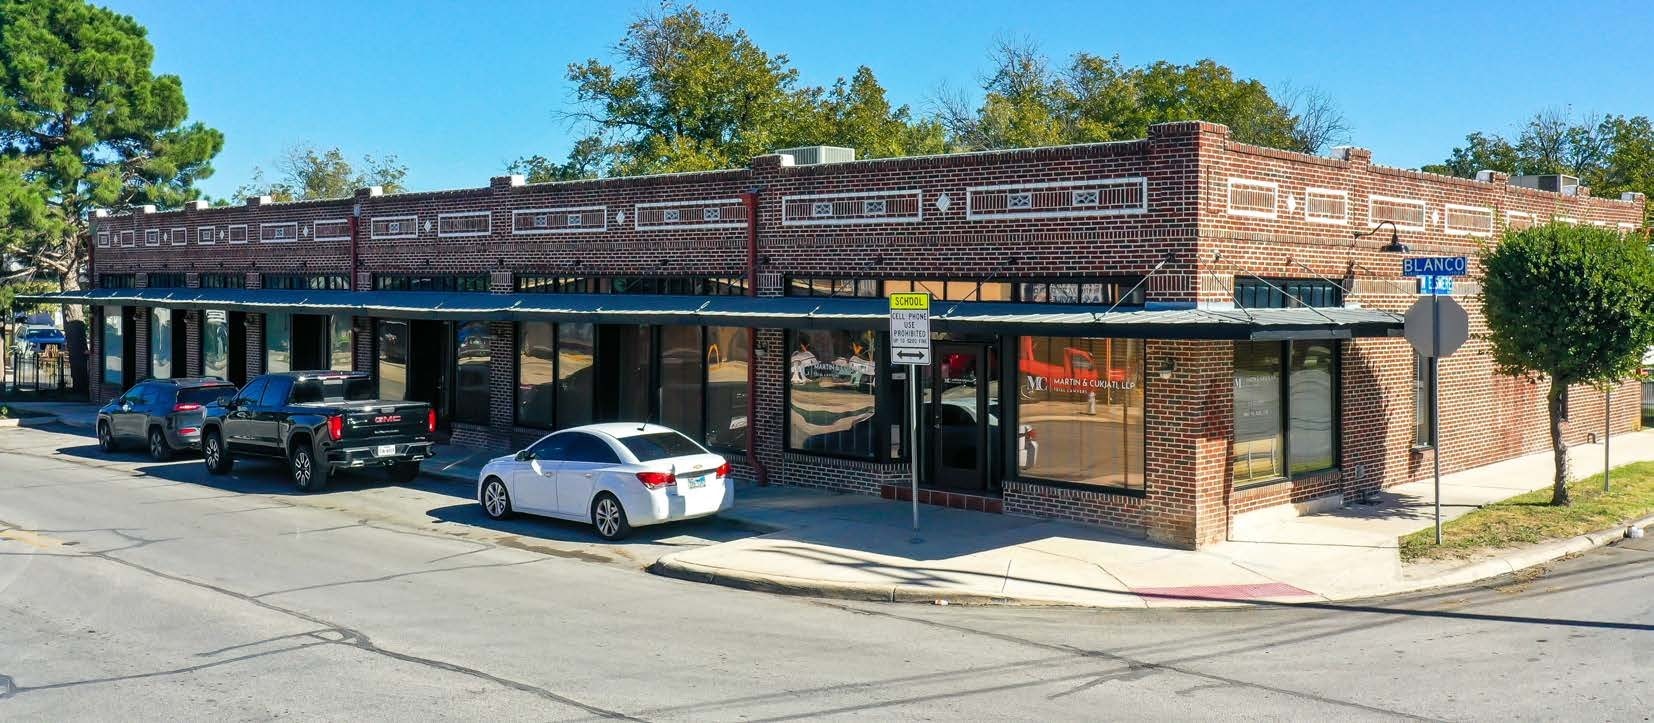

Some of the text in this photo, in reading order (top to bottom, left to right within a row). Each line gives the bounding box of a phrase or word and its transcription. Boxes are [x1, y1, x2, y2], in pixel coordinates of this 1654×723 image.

[1404, 257, 1464, 271] BLANCO
[895, 297, 923, 306] SCHOOL
[908, 313, 927, 321] PHONE
[894, 330, 926, 338] PROHIBITED
[1027, 375, 1048, 391] MC
[1054, 378, 1081, 386] MARTIN
[1082, 379, 1088, 387] &
[1121, 382, 1136, 390] LLP
[374, 415, 401, 423] GMC
